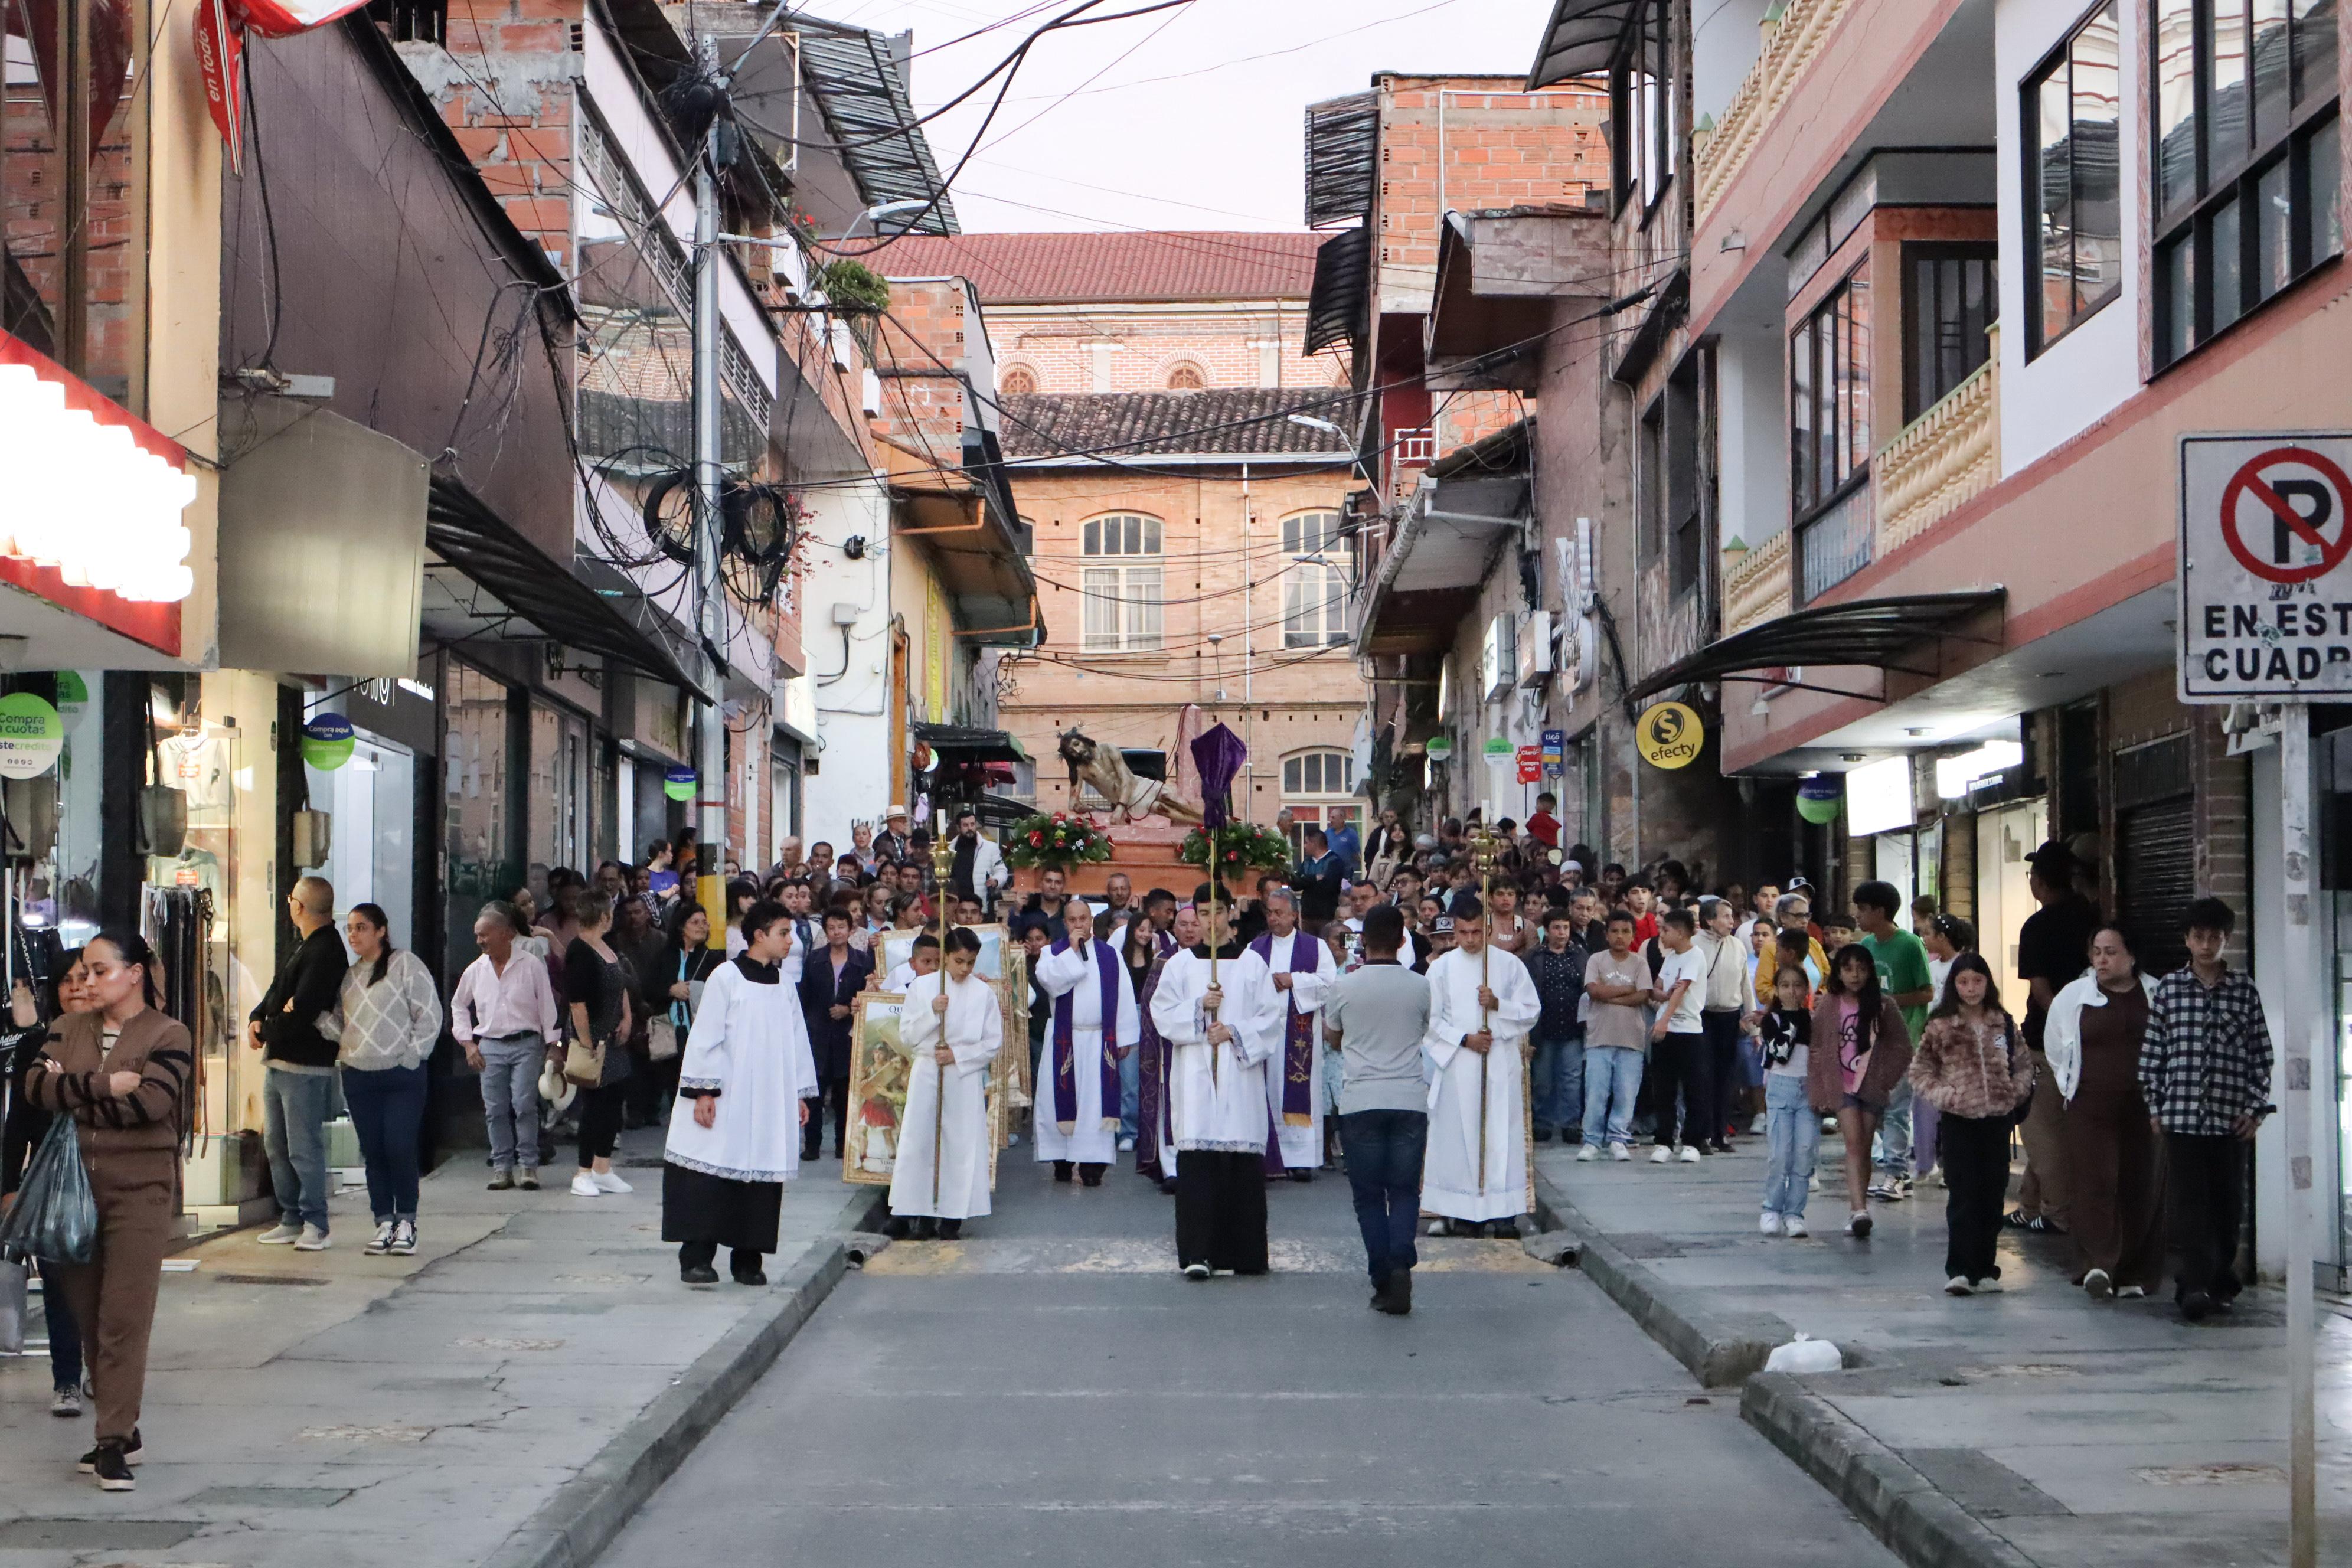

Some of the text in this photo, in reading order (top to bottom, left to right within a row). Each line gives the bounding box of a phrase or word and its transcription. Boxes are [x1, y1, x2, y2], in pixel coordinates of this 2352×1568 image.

[198, 28, 220, 103] en todo.
[2204, 604, 2258, 638] EN
[0, 713, 45, 725] Compra
[5, 724, 46, 734] cuotas
[1651, 743, 1694, 762] efecty
